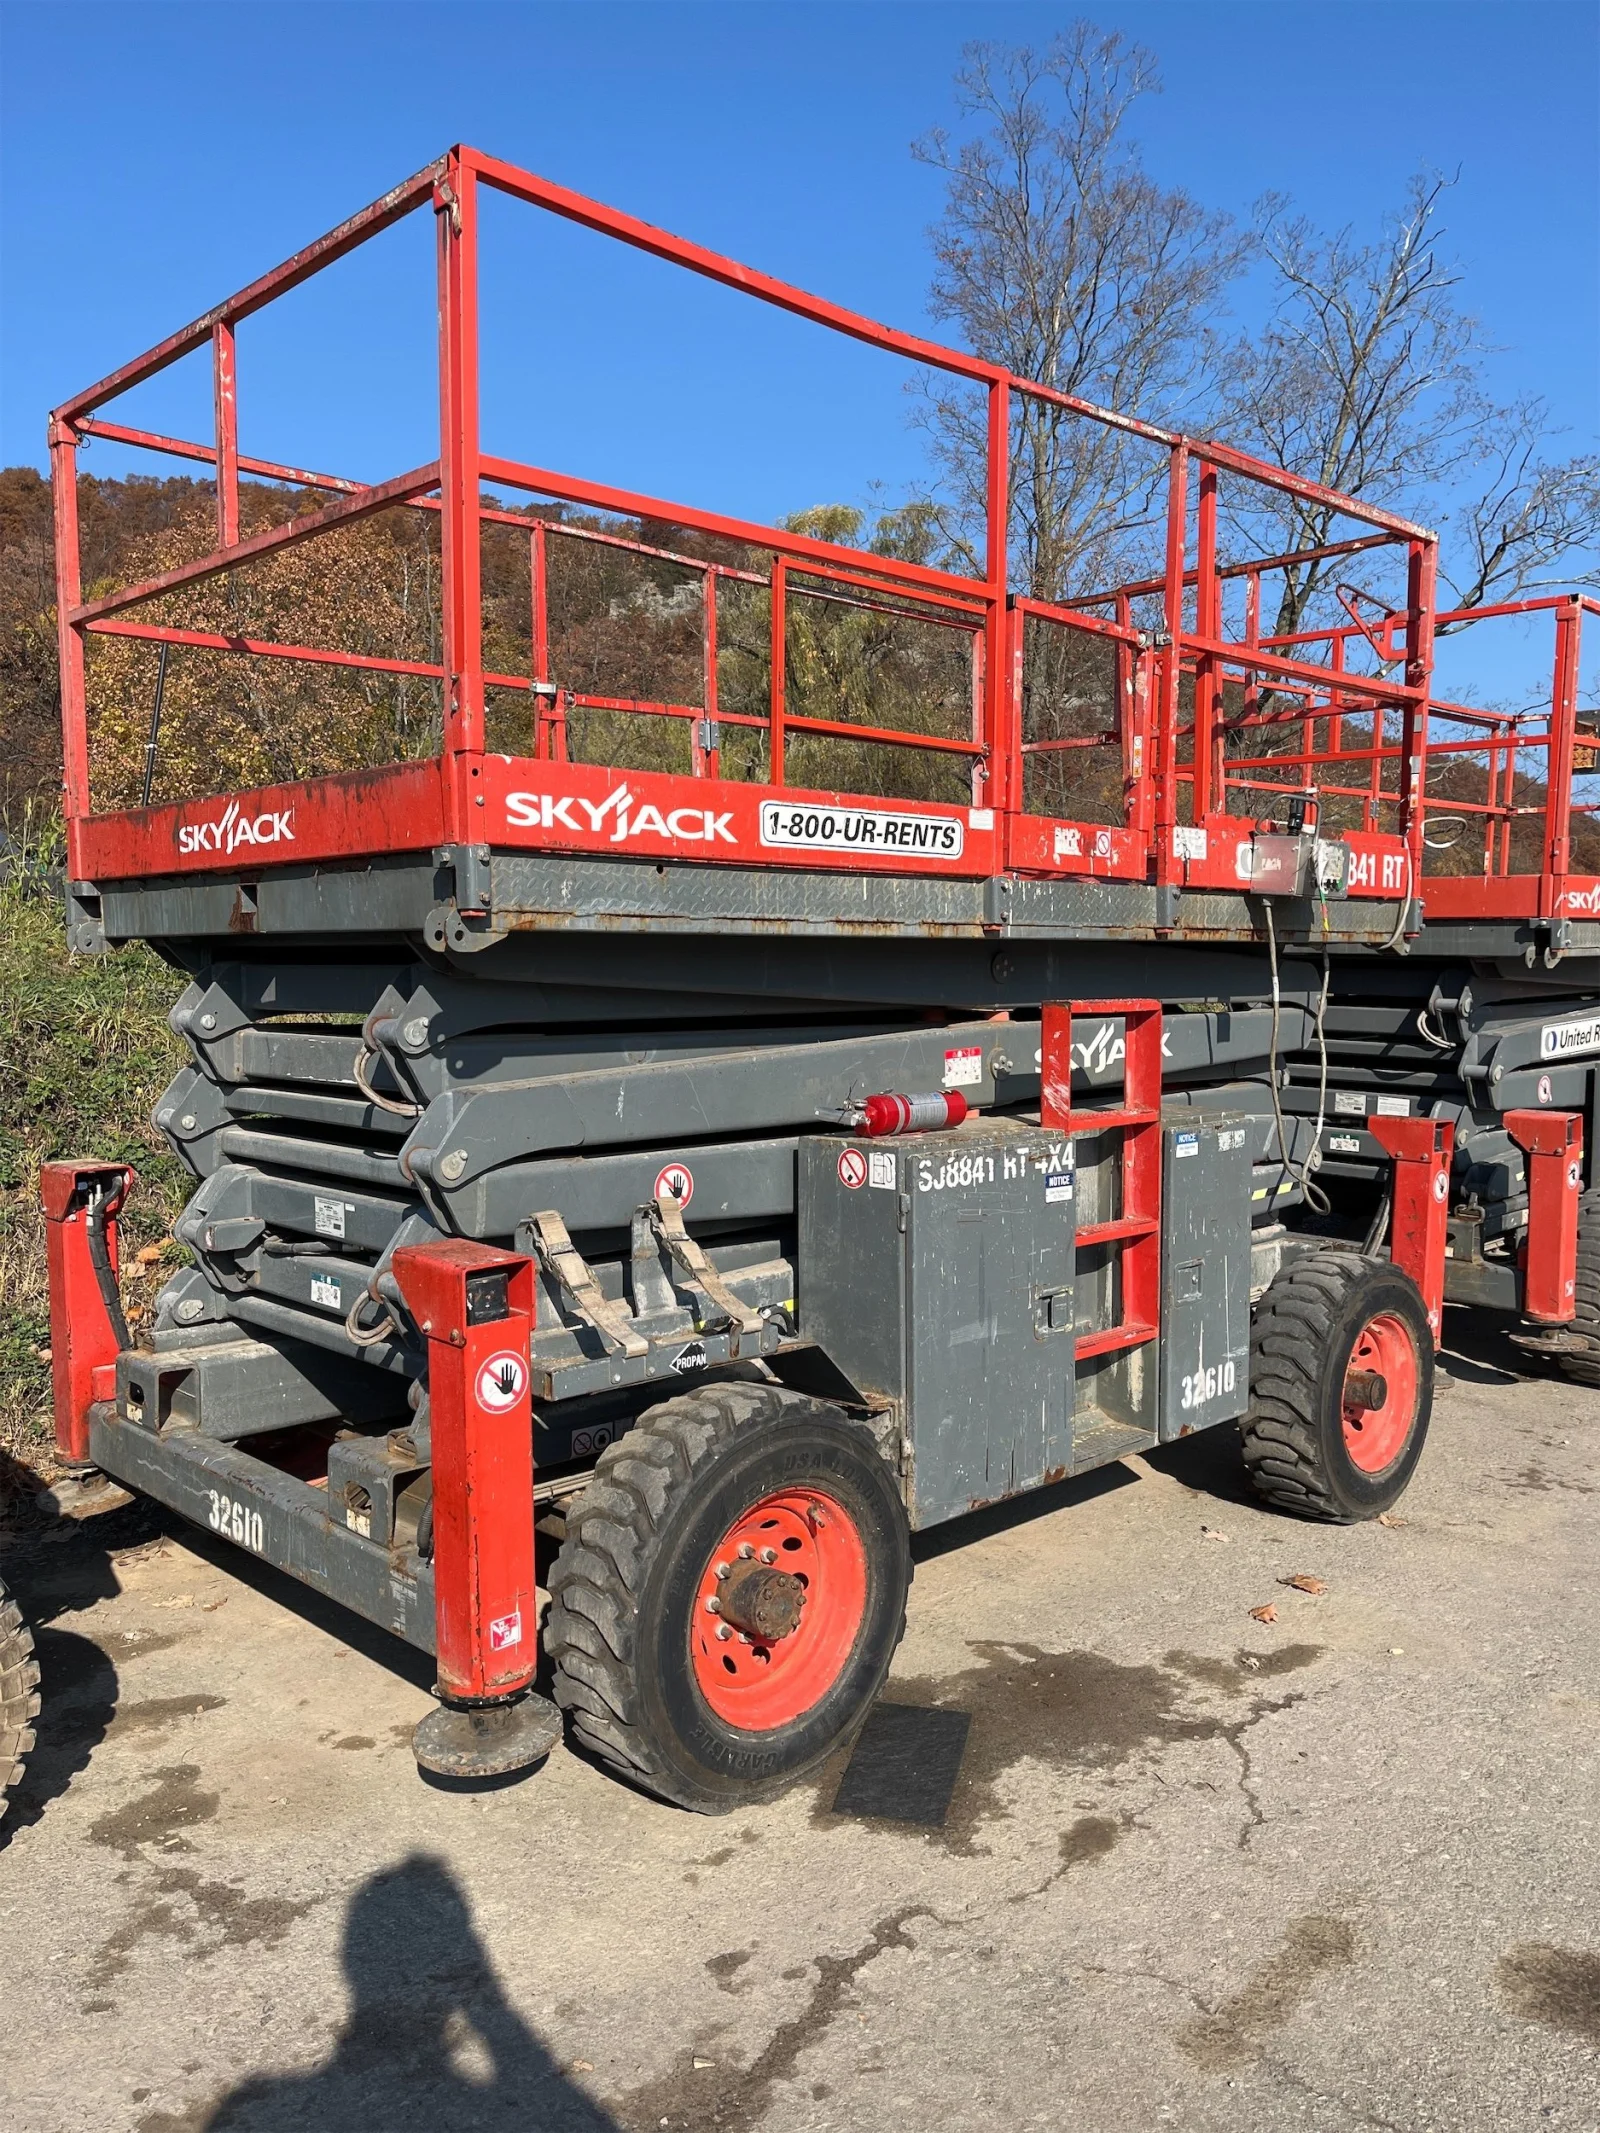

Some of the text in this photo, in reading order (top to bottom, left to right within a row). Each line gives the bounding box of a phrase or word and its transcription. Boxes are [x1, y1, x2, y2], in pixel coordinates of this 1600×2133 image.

[179, 799, 296, 855] SKYJACK
[505, 781, 739, 843] SKYJACK
[768, 811, 956, 849] 1-800-UR-RENTS
[1382, 854, 1404, 889] RT
[1560, 1025, 1593, 1049] United
[1178, 1133, 1197, 1144] NOTICE
[918, 1154, 995, 1193] SJ8841
[1049, 1174, 1070, 1187] NOTICE
[1180, 1360, 1235, 1410] 32610
[208, 1488, 263, 1553] 32610
